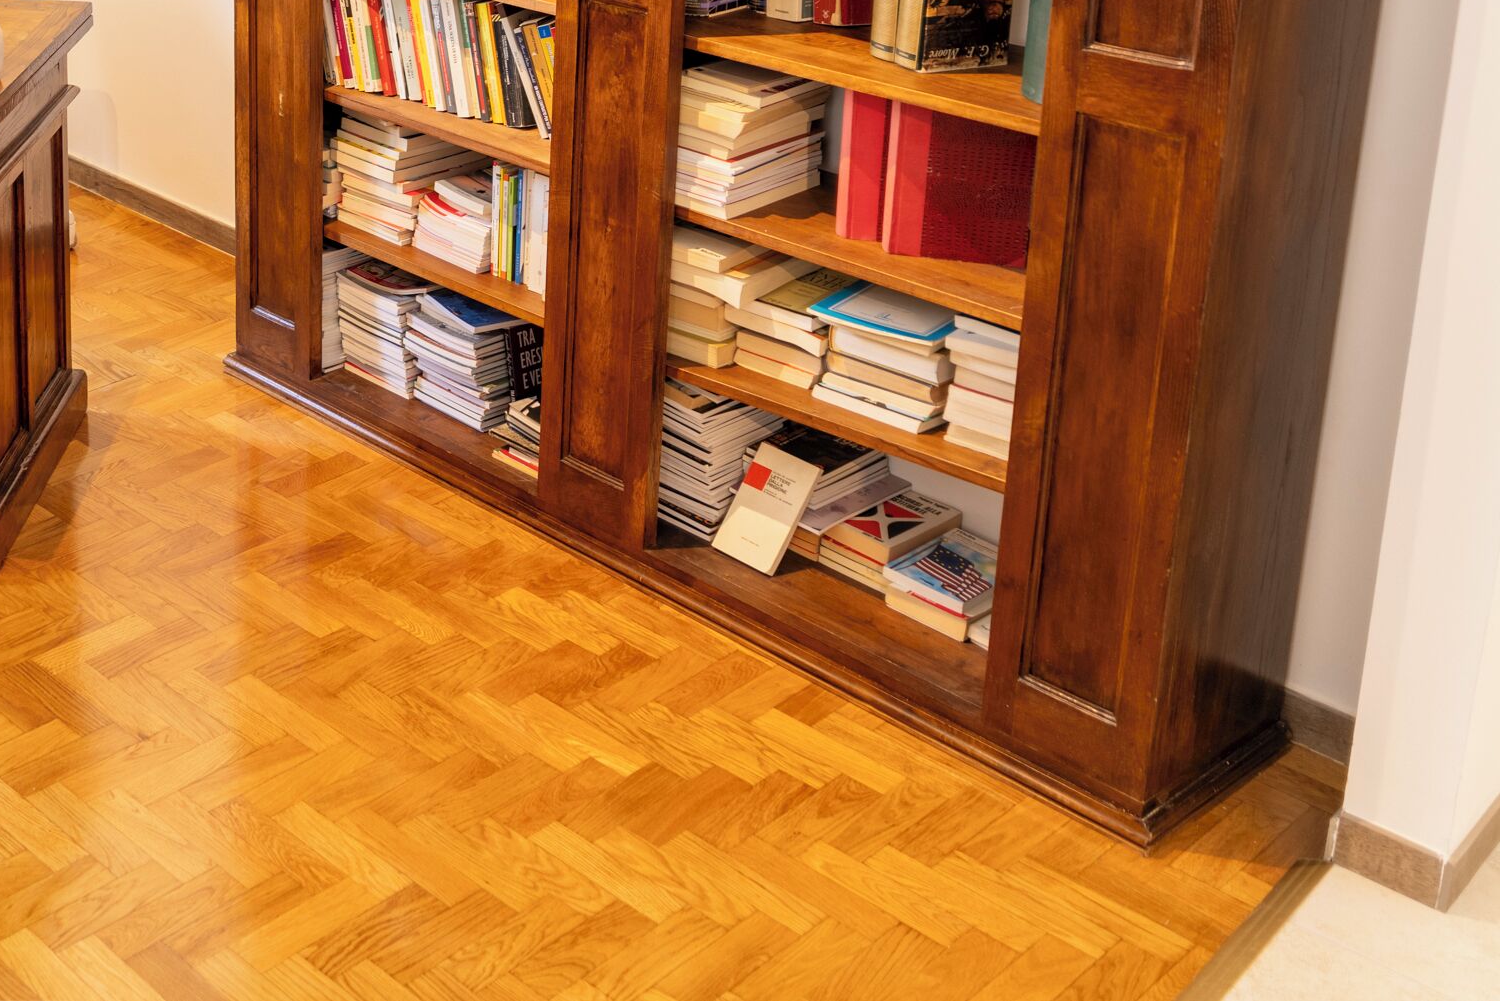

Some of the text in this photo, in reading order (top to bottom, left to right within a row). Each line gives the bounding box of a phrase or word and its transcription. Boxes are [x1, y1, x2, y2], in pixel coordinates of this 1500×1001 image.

[928, 46, 960, 59] Moore
[517, 328, 536, 348] TRA
[522, 373, 529, 390] E
[769, 479, 783, 488] DALLA
[770, 474, 791, 487] LETTERE
[767, 483, 787, 495] PRIGIONE
[925, 506, 942, 516] ALLA
